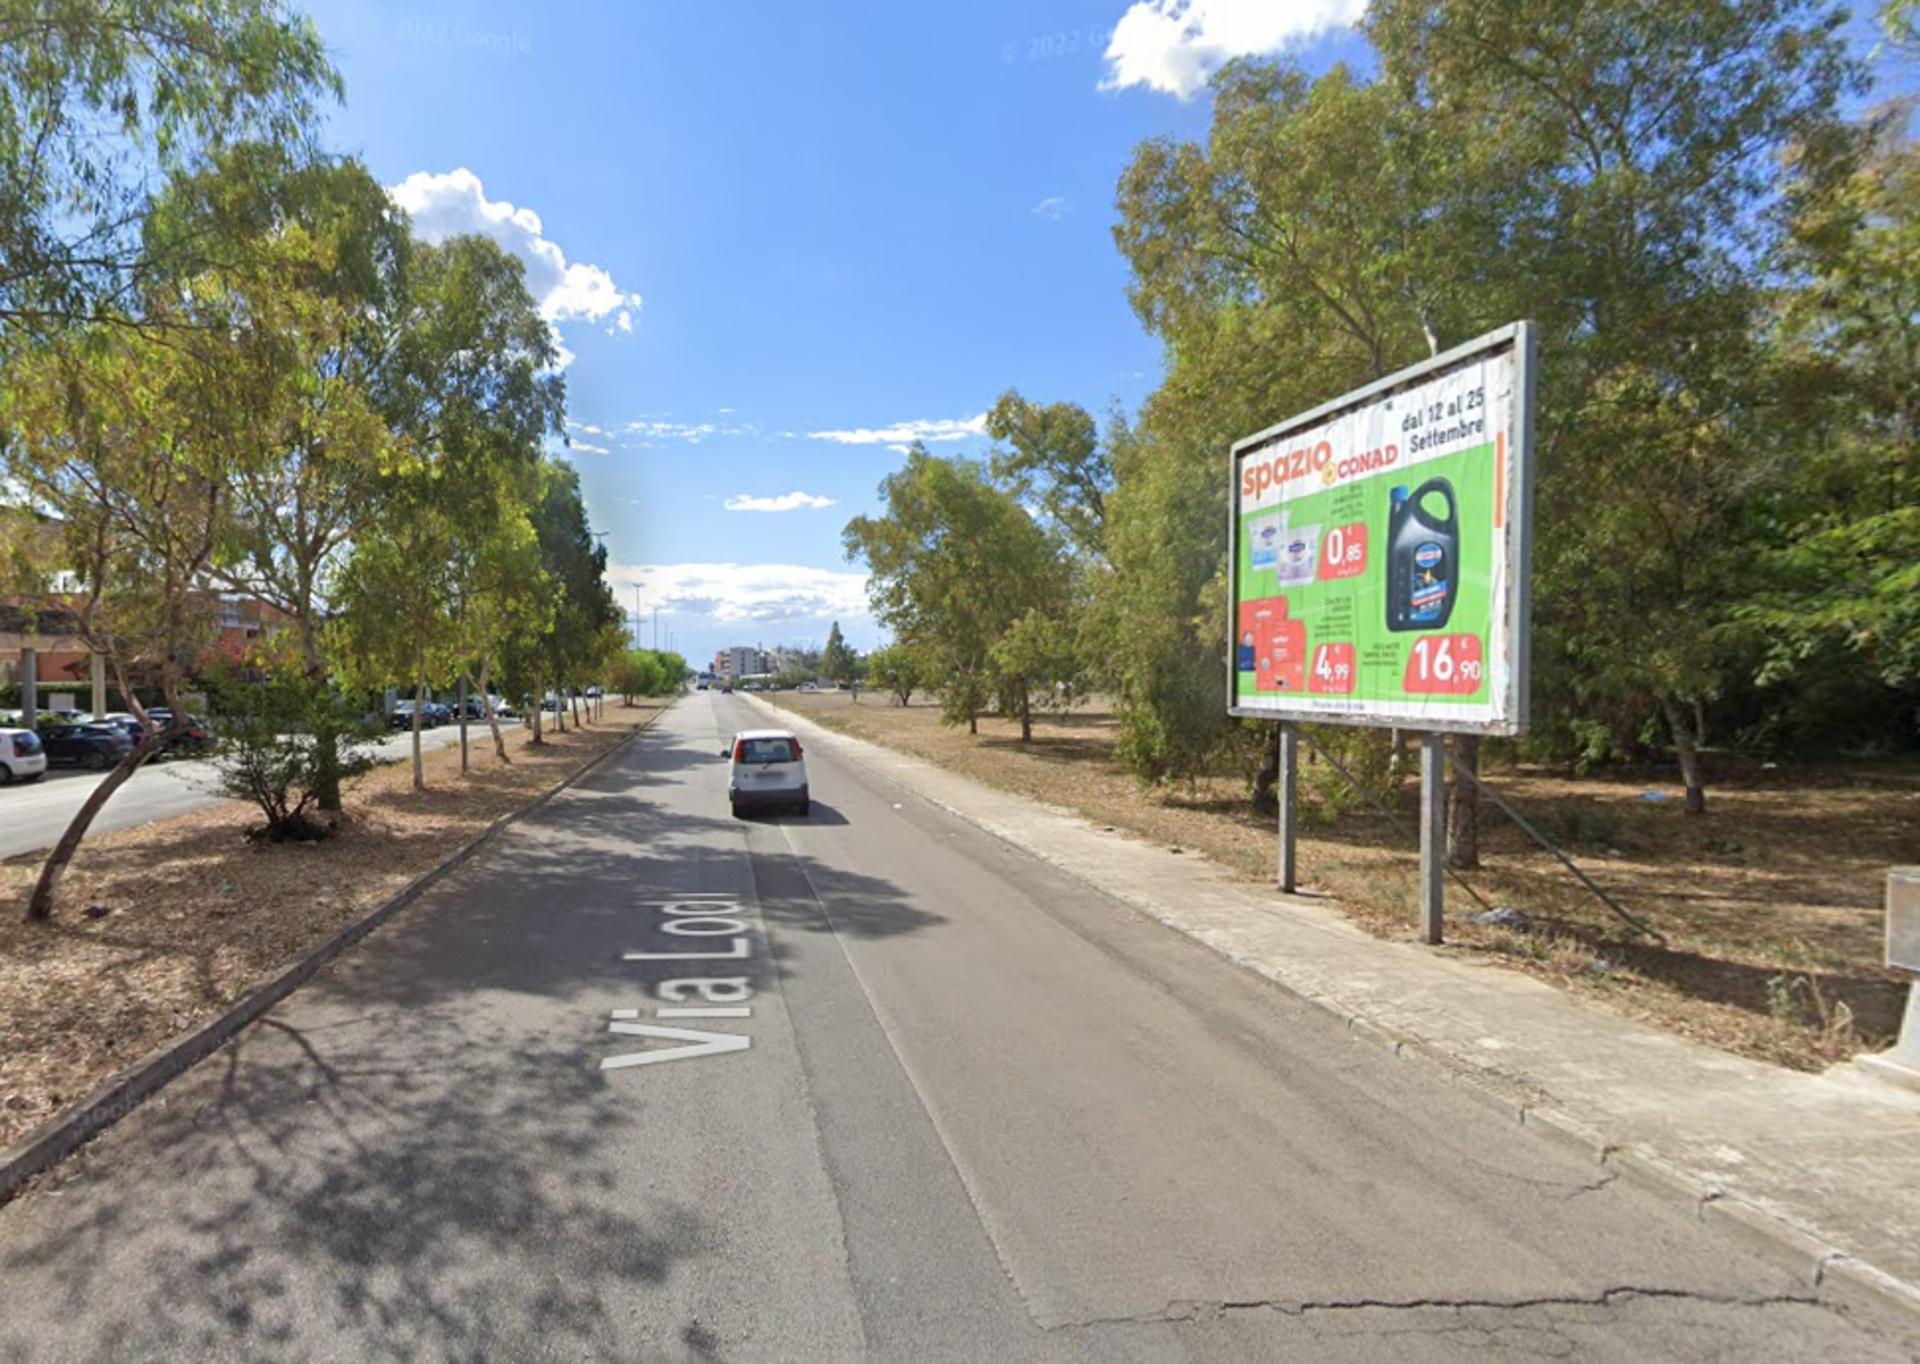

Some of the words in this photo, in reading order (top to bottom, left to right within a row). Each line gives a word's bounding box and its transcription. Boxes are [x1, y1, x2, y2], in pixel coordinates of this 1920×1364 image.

[1402, 410, 1423, 432] dal
[1428, 402, 1443, 423] 12
[1447, 395, 1461, 416] al
[1466, 386, 1484, 410] 25
[1409, 418, 1484, 453] Settembre
[1242, 440, 1331, 500] spazio
[1337, 444, 1398, 479] CONAD
